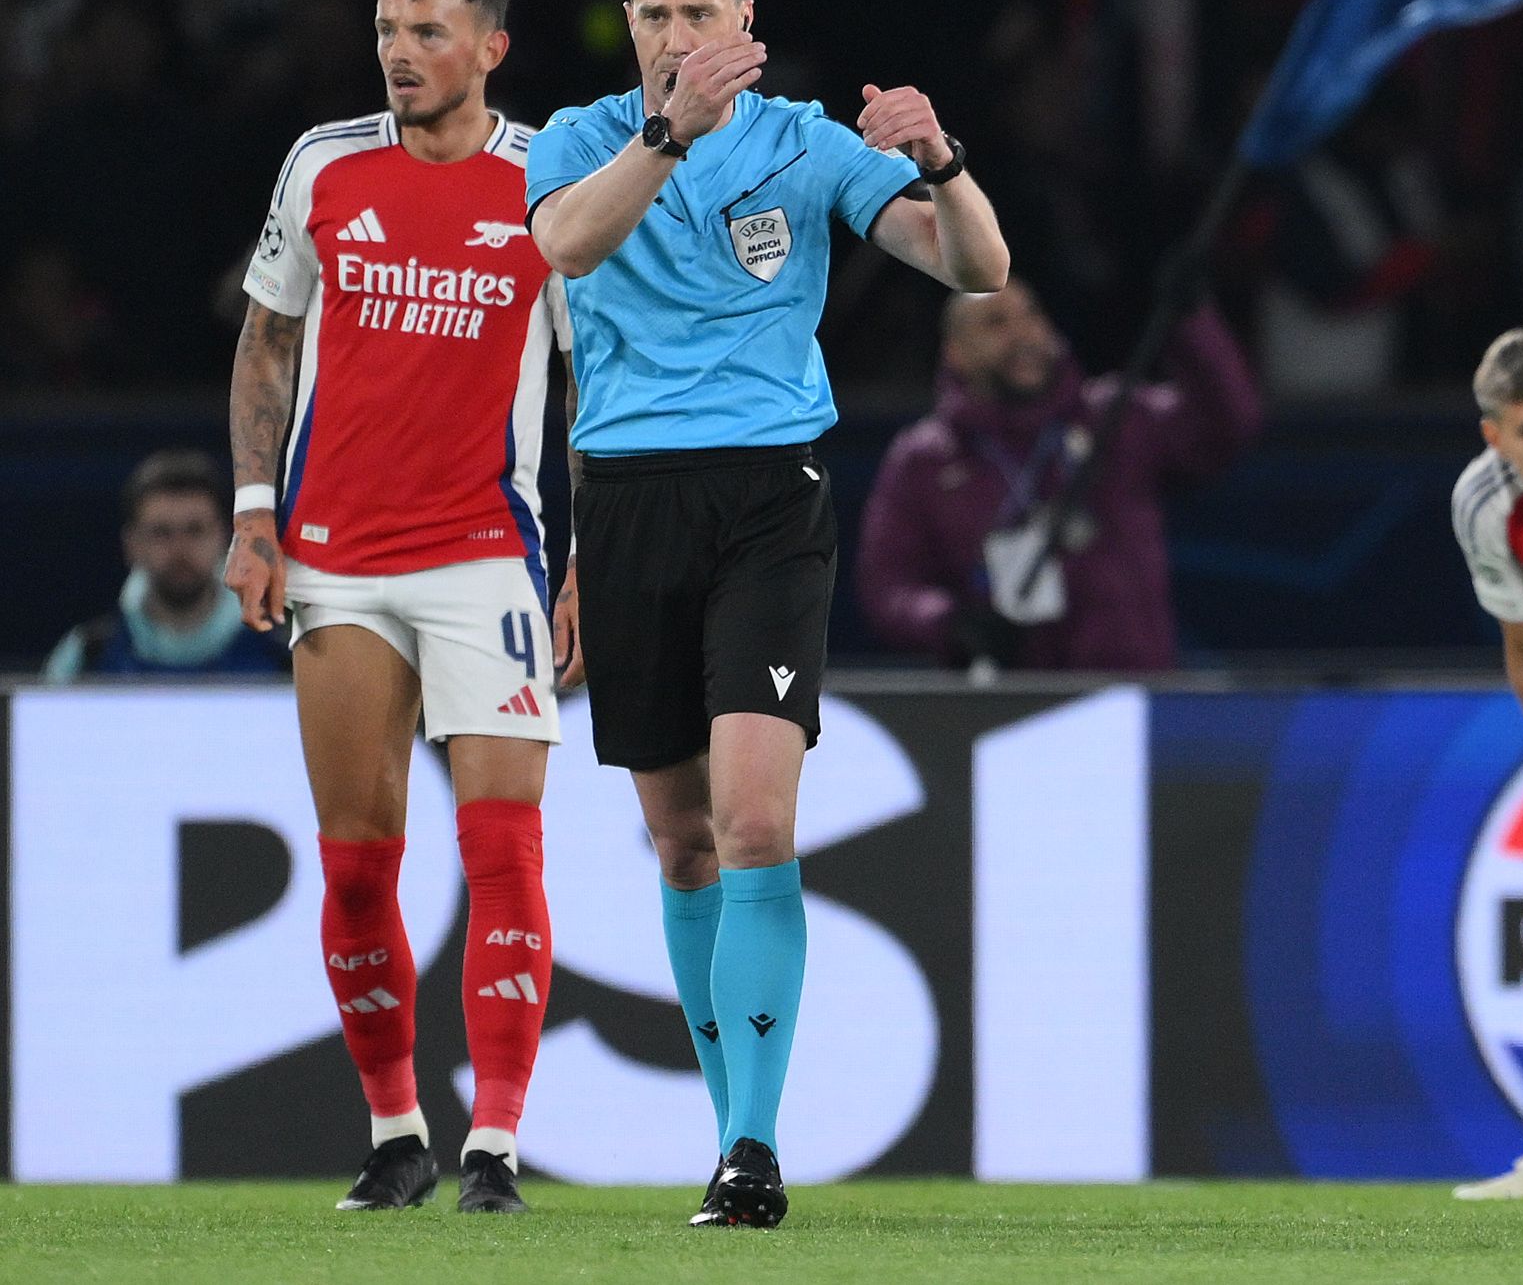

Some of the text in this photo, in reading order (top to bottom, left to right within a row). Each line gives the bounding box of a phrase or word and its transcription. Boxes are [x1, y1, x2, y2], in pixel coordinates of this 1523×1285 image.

[741, 220, 776, 238] UEFA
[746, 248, 786, 266] OFFICIAL
[747, 238, 781, 254] MATCH
[337, 253, 516, 307] Emirates
[358, 297, 485, 340] FLY BETTER
[500, 609, 536, 680] 4
[485, 928, 543, 951] AFC
[328, 948, 389, 972] AFC
